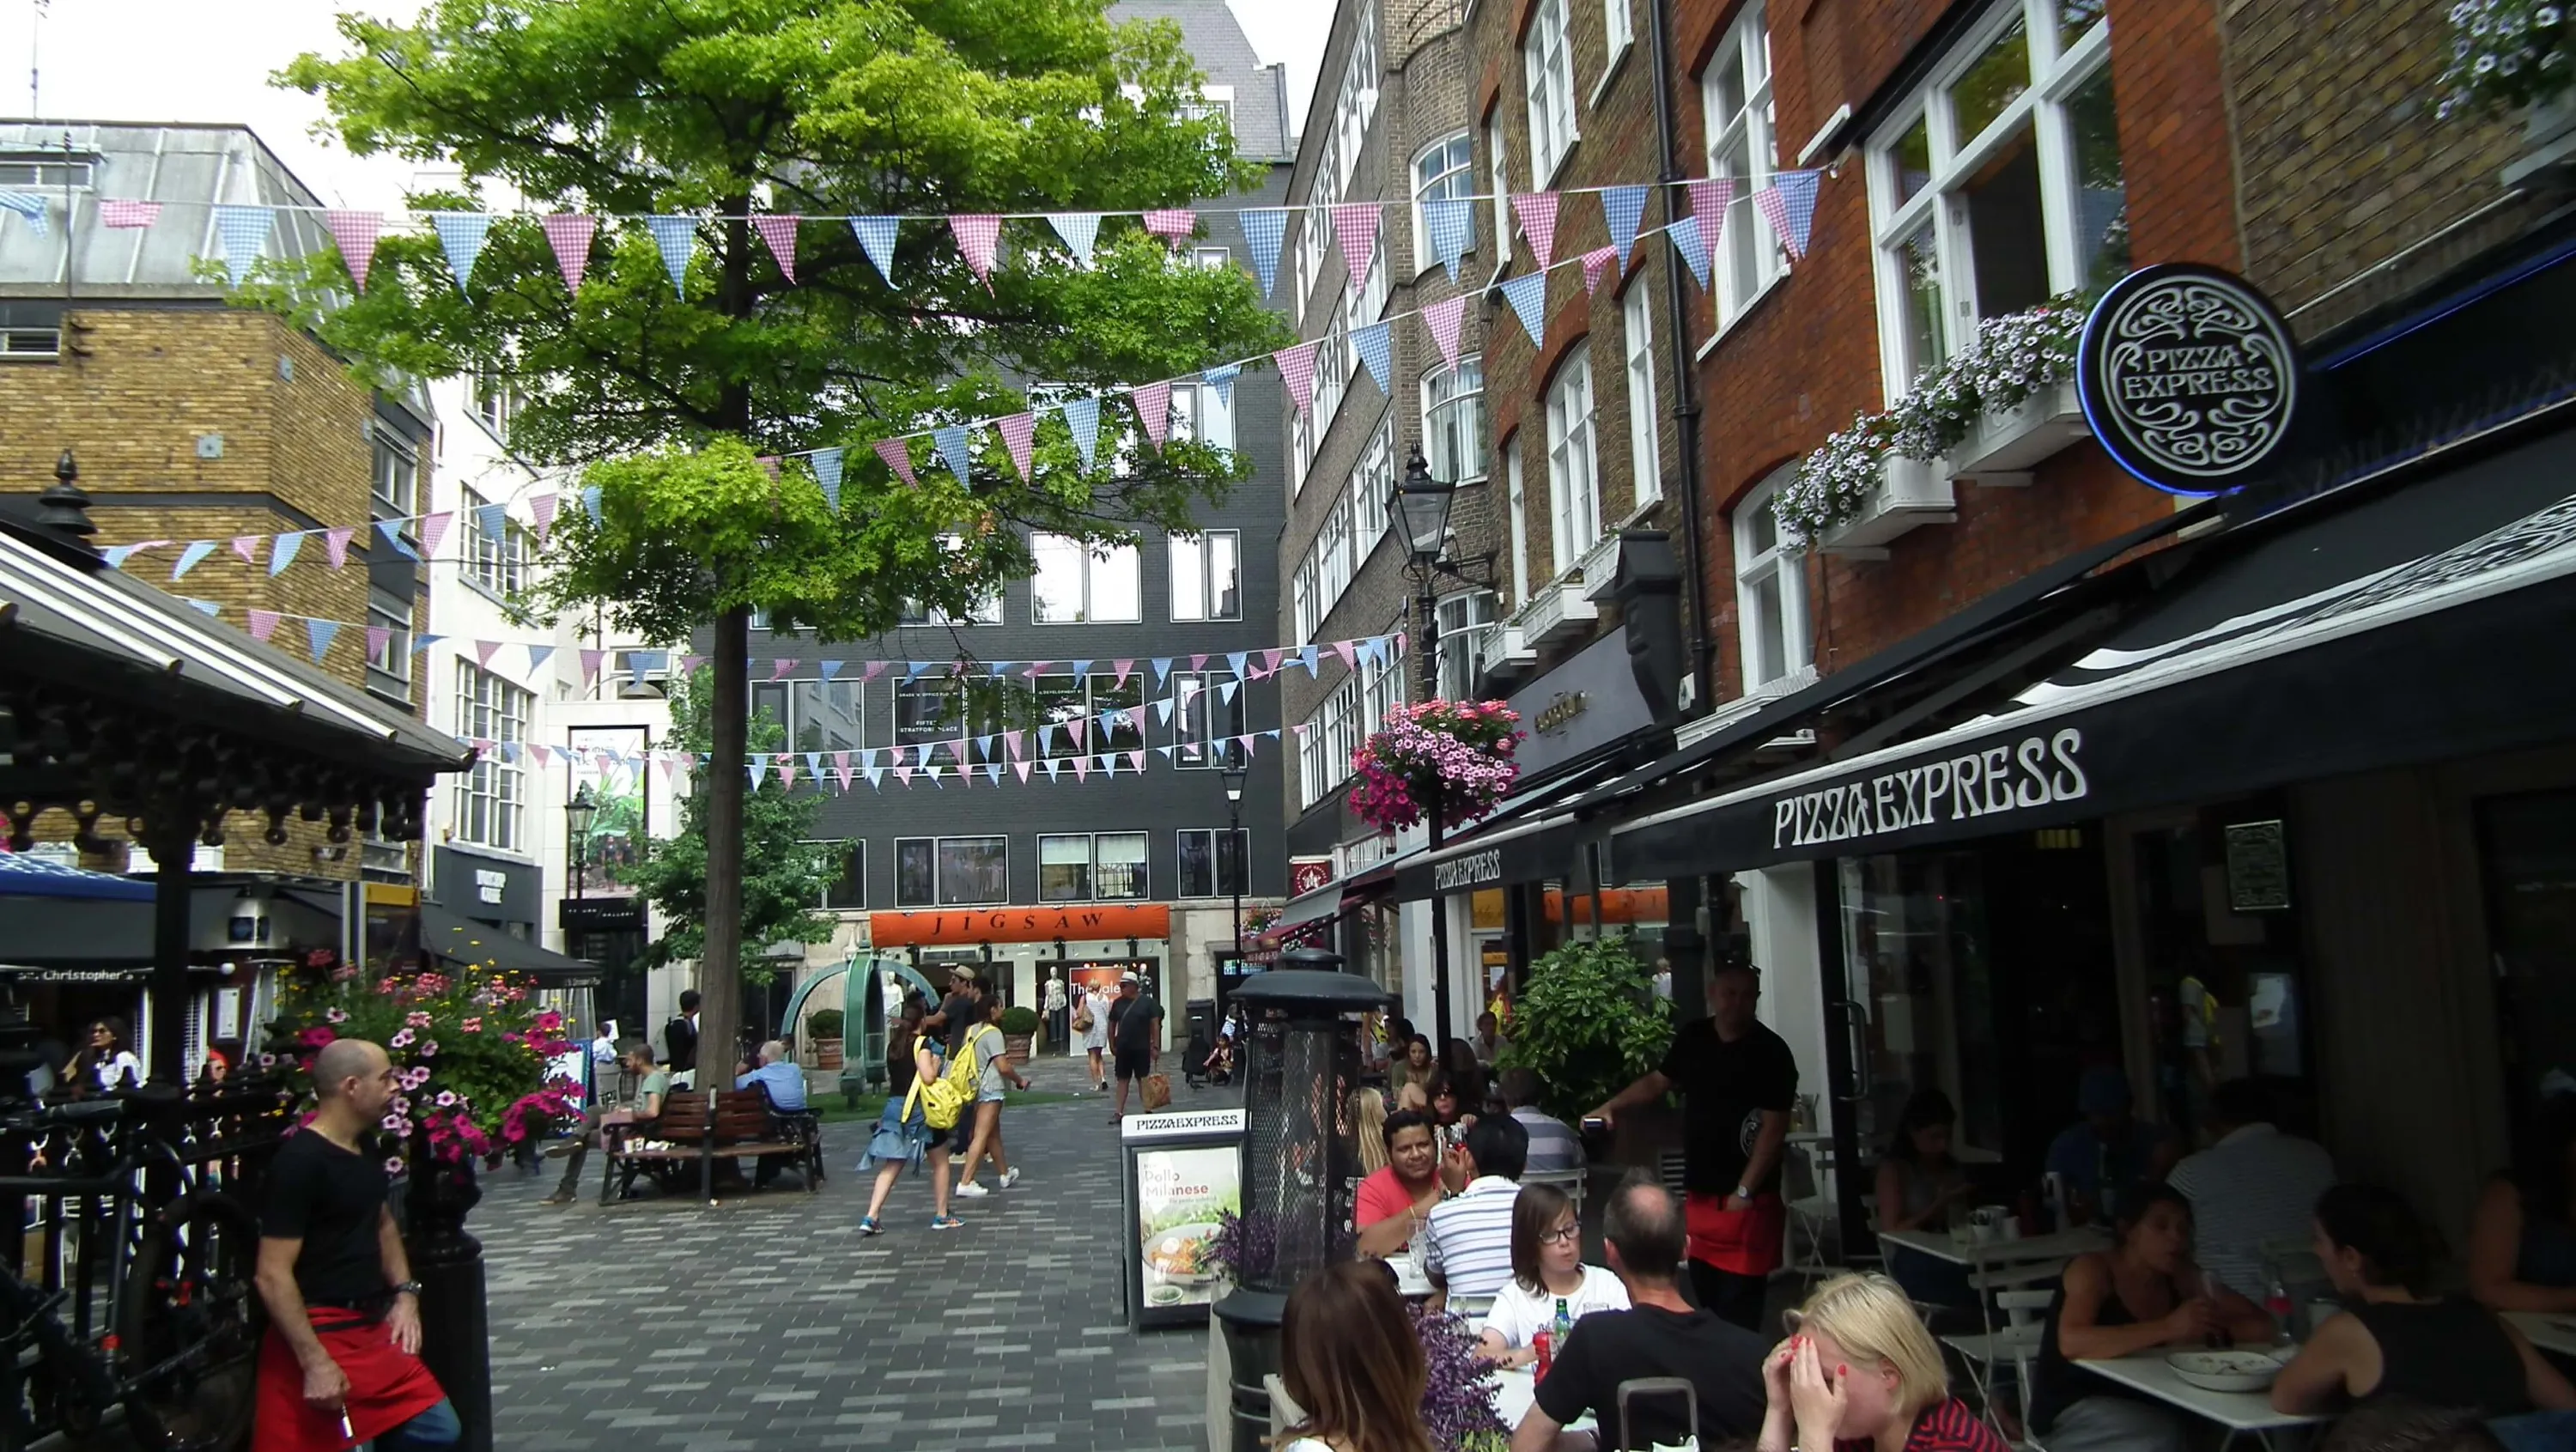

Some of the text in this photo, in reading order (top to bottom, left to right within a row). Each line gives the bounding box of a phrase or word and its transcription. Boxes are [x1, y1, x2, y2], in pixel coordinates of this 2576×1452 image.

[2146, 344, 2244, 373] PIZZA
[2123, 368, 2275, 400] EXPRESS
[931, 911, 1106, 935] JIGSAW
[1137, 1115, 1238, 1131] PIZZAEXPRESS
[1145, 1169, 1181, 1182] Pollo
[1145, 1183, 1209, 1197] Milanese
